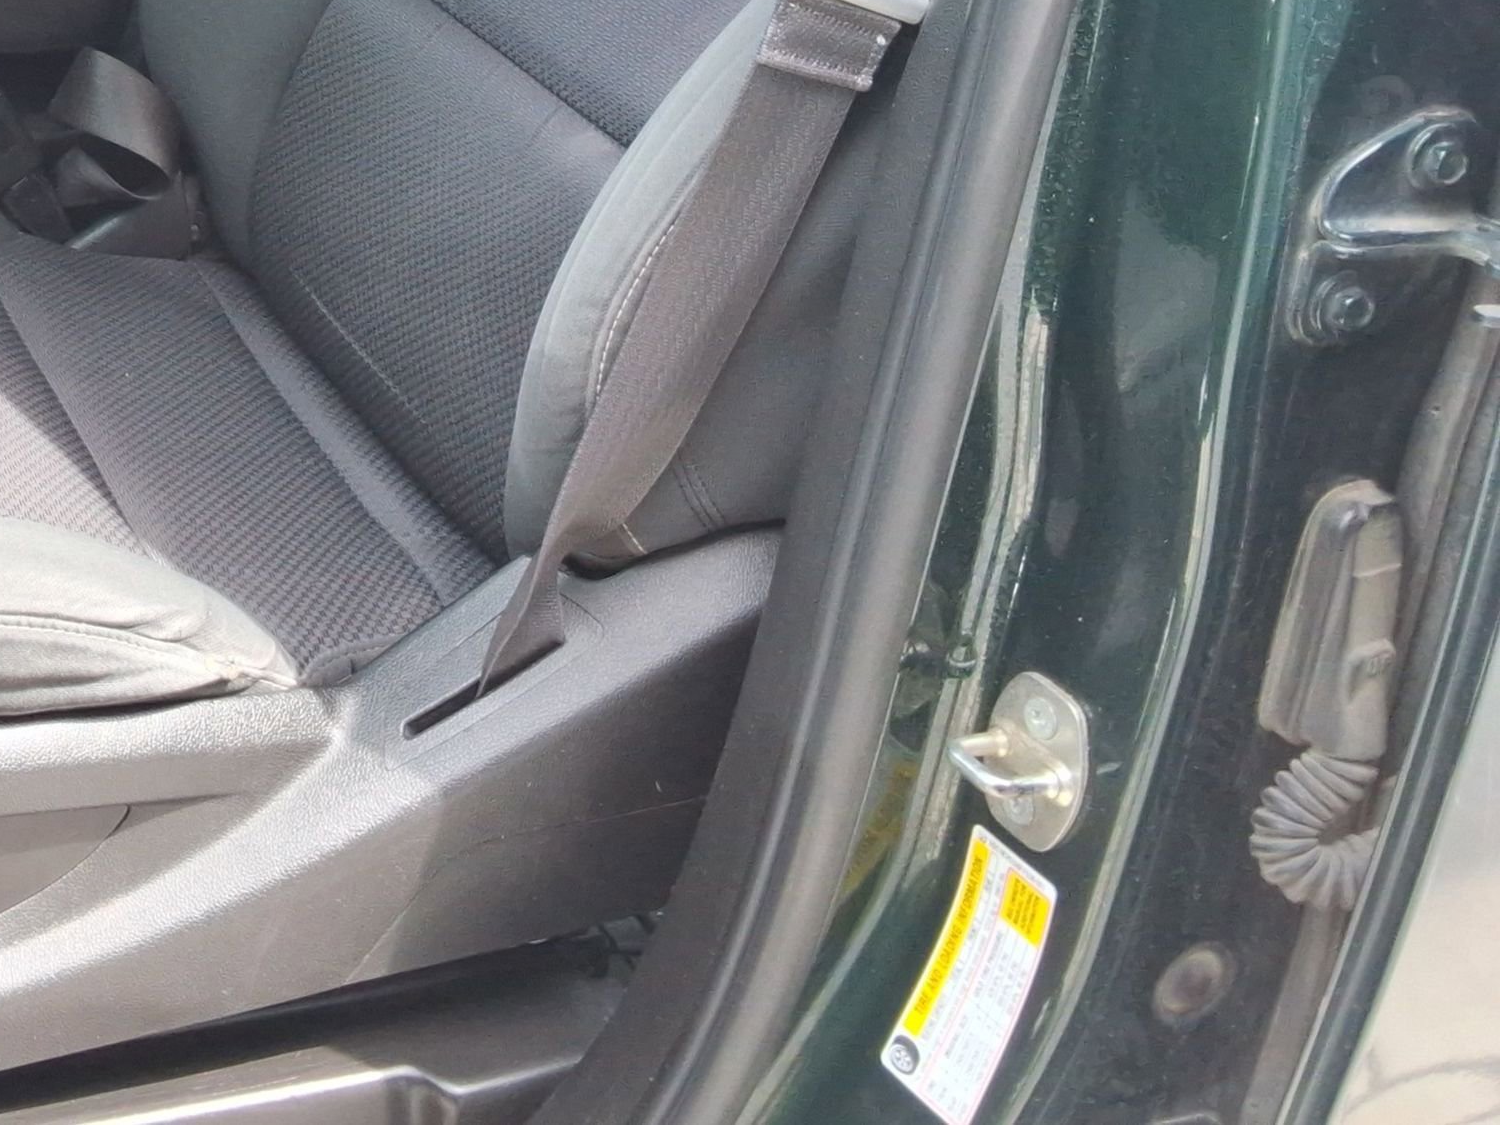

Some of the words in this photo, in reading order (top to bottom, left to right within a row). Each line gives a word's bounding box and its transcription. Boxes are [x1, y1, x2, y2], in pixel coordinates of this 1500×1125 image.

[914, 990, 931, 1016] TIRE
[928, 968, 943, 993] AND
[940, 924, 963, 971] LOADING
[957, 857, 983, 924] INFORMATION
